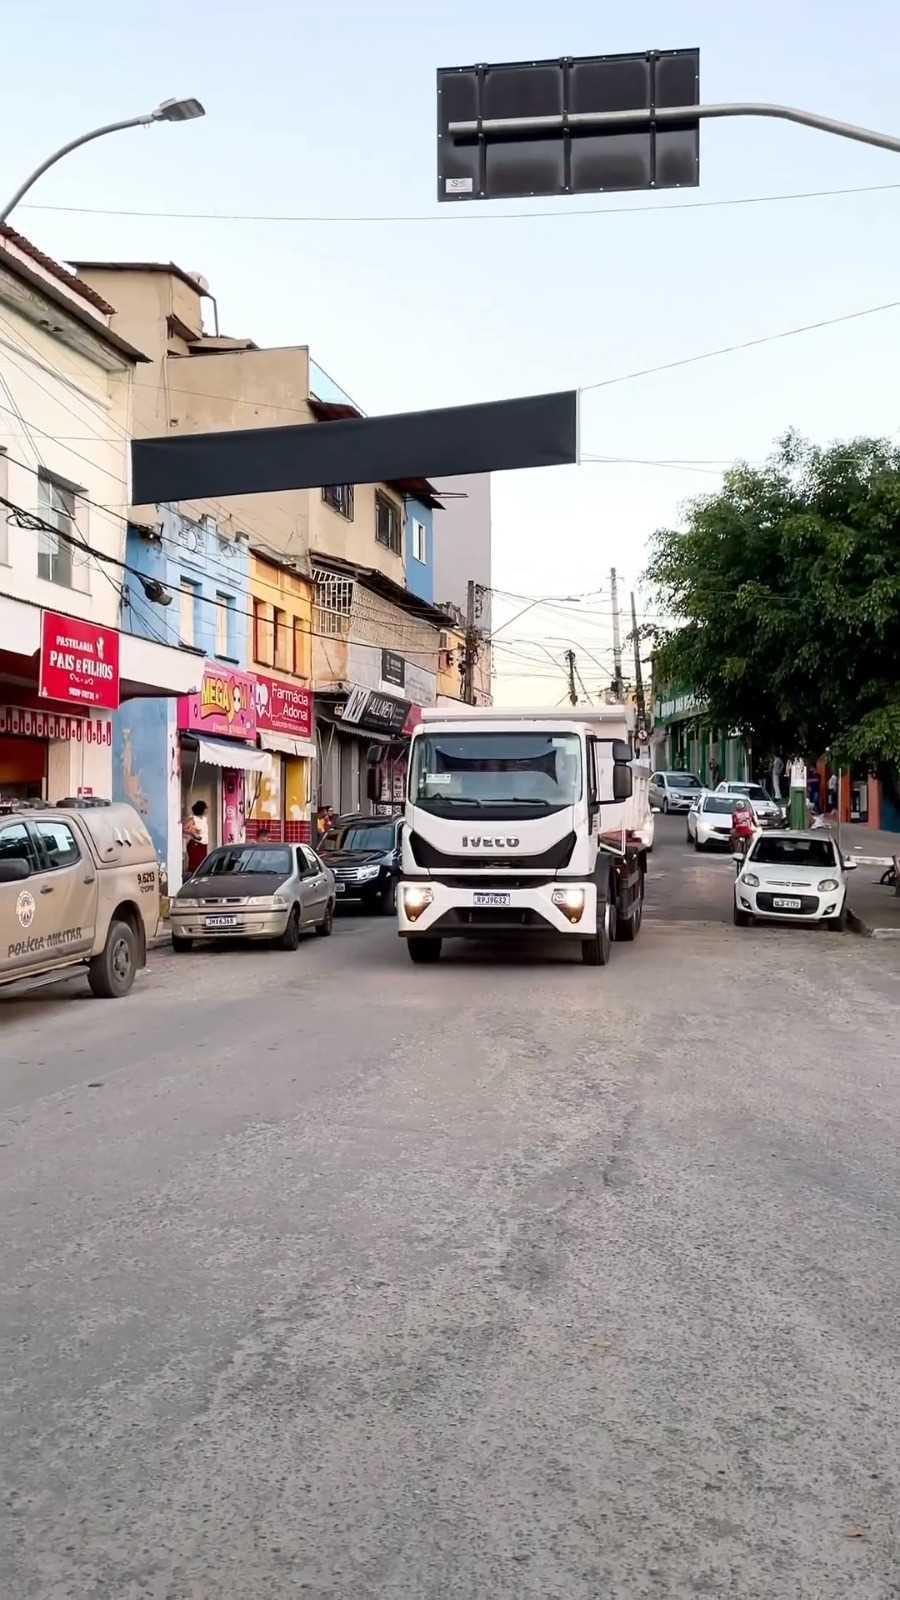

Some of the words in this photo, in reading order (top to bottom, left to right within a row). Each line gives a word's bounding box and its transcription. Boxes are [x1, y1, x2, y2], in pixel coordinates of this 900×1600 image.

[56, 635, 94, 653] PASTELARIA
[49, 650, 75, 671] PAIS
[82, 658, 113, 680] FILHOS
[271, 682, 309, 706] Farmácia
[462, 835, 520, 847] IVECO
